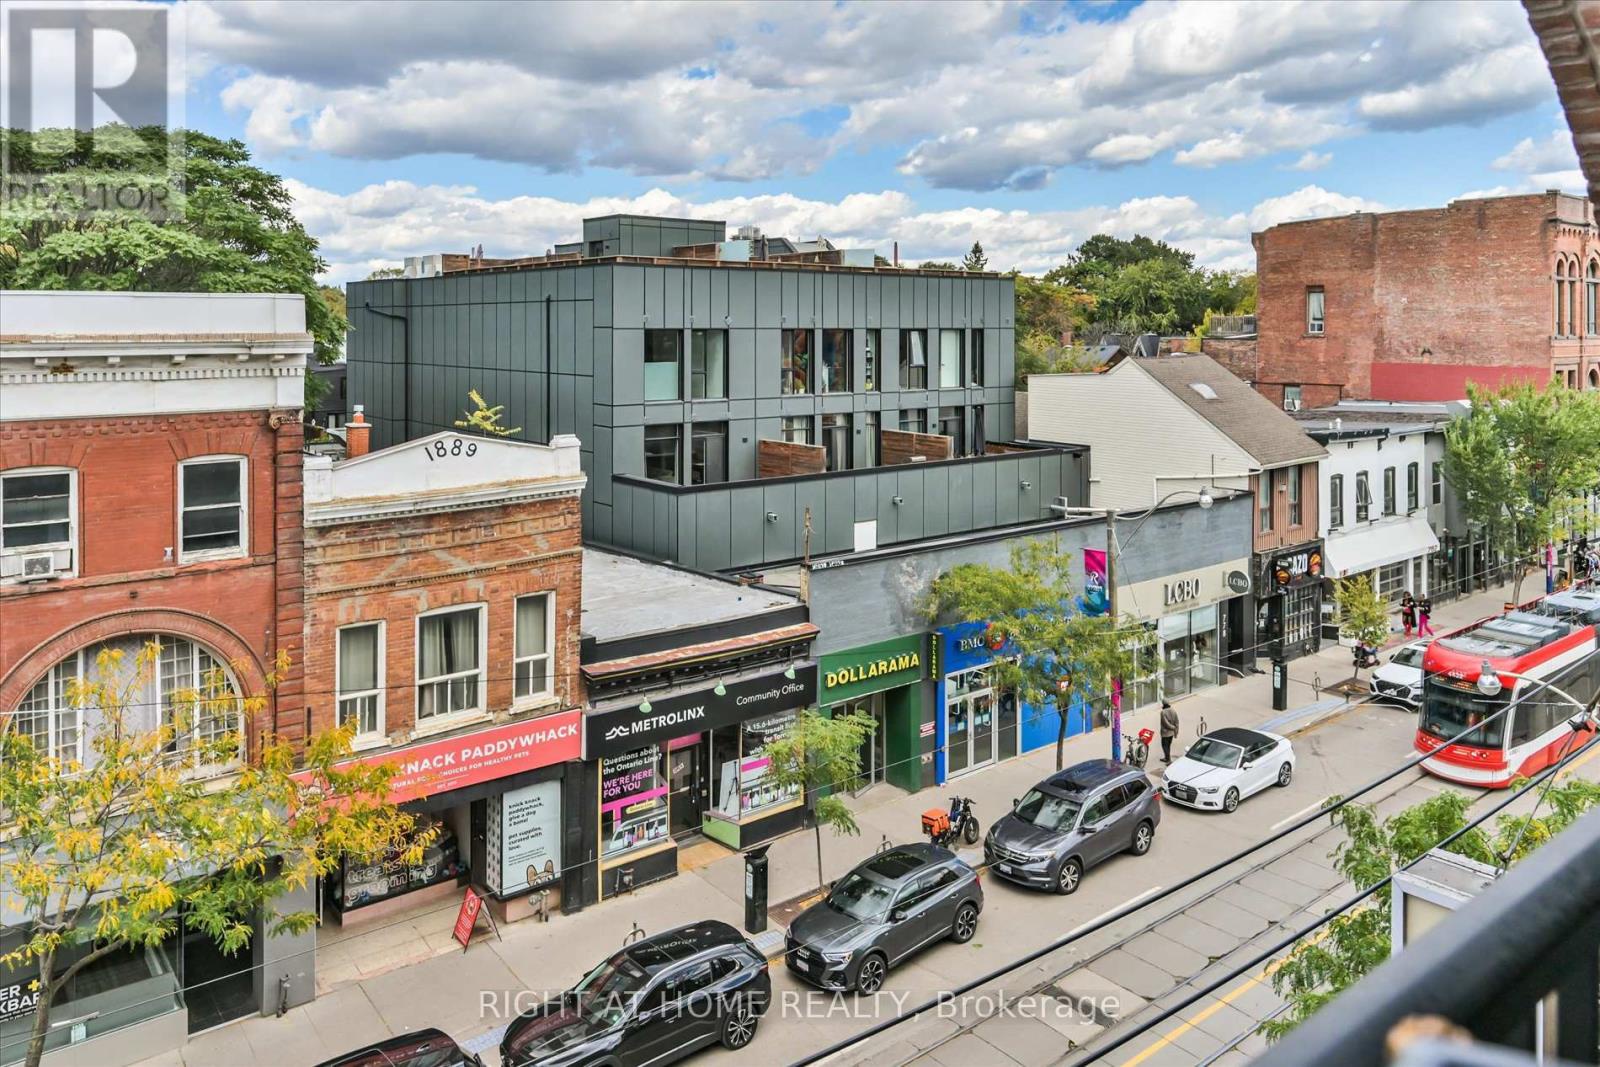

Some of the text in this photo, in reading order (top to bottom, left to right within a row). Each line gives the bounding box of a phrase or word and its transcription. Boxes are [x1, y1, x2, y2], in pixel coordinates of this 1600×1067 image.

[424, 438, 478, 461] 1889
[1165, 577, 1201, 606] LCBO
[1229, 576, 1248, 588] LCBO
[826, 652, 920, 688] DOLLARAMA
[736, 683, 805, 706] Community Office
[631, 706, 705, 735] METROLINX
[461, 723, 578, 761] PADDYWHACK
[469, 762, 483, 770] FOR
[483, 754, 513, 768] HEALTHY
[514, 750, 530, 759] PETS
[603, 746, 660, 766] Questions about
[603, 752, 663, 775] the Ontario Line?
[603, 768, 654, 790] WE'RE HERE
[603, 780, 641, 799] FOR YOU
